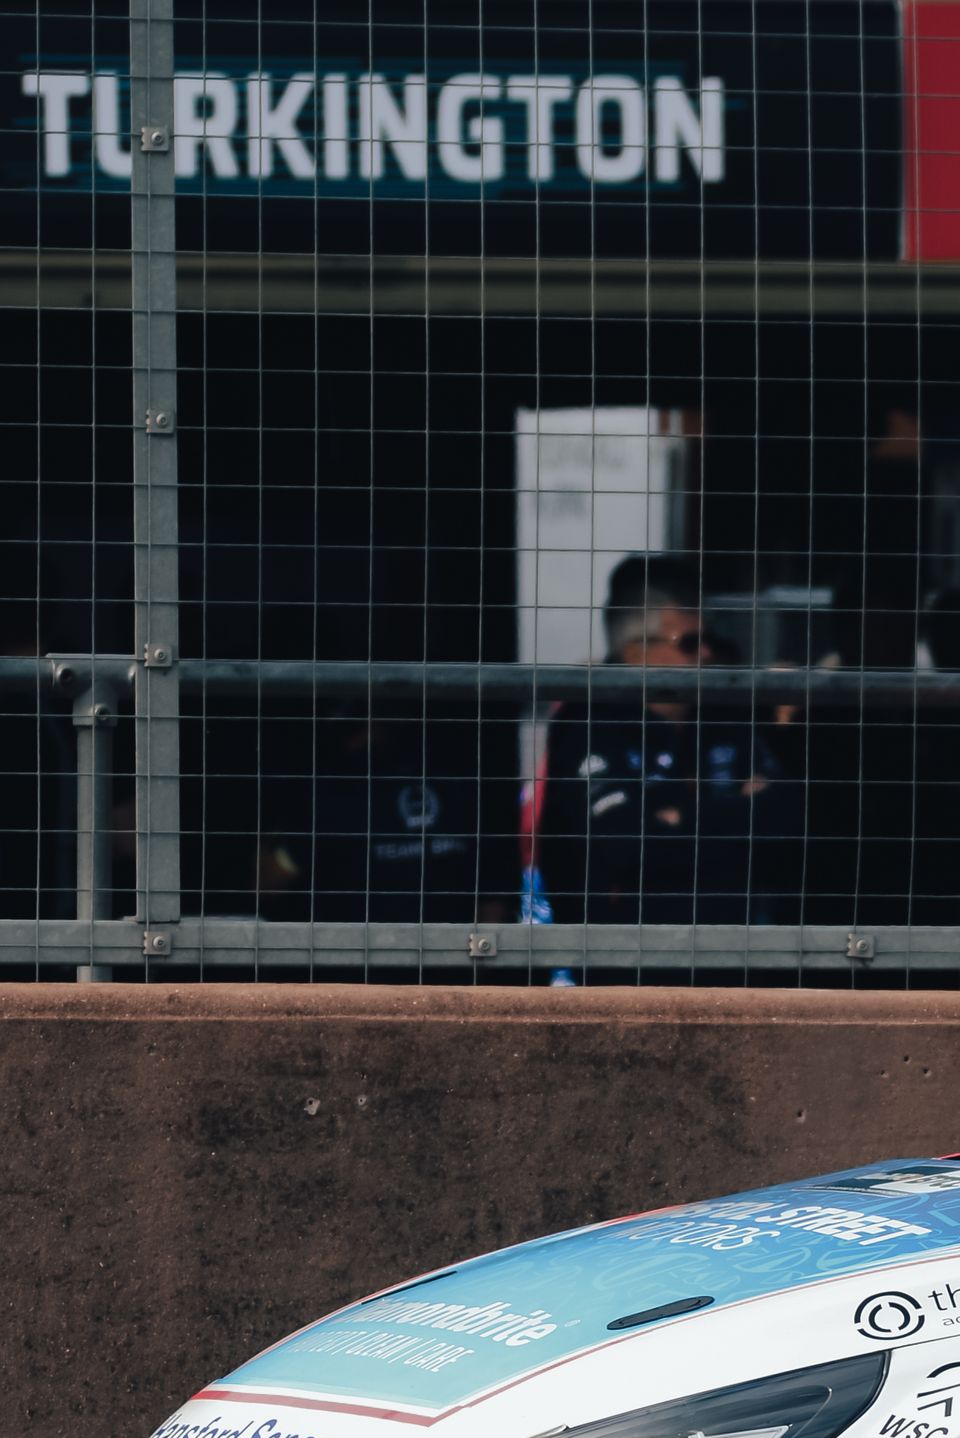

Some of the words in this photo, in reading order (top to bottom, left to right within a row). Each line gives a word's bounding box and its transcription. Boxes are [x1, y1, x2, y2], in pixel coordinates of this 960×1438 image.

[22, 70, 725, 184] TURKINGTON
[755, 1206, 932, 1247] STREET
[404, 1341, 475, 1373] CARE
